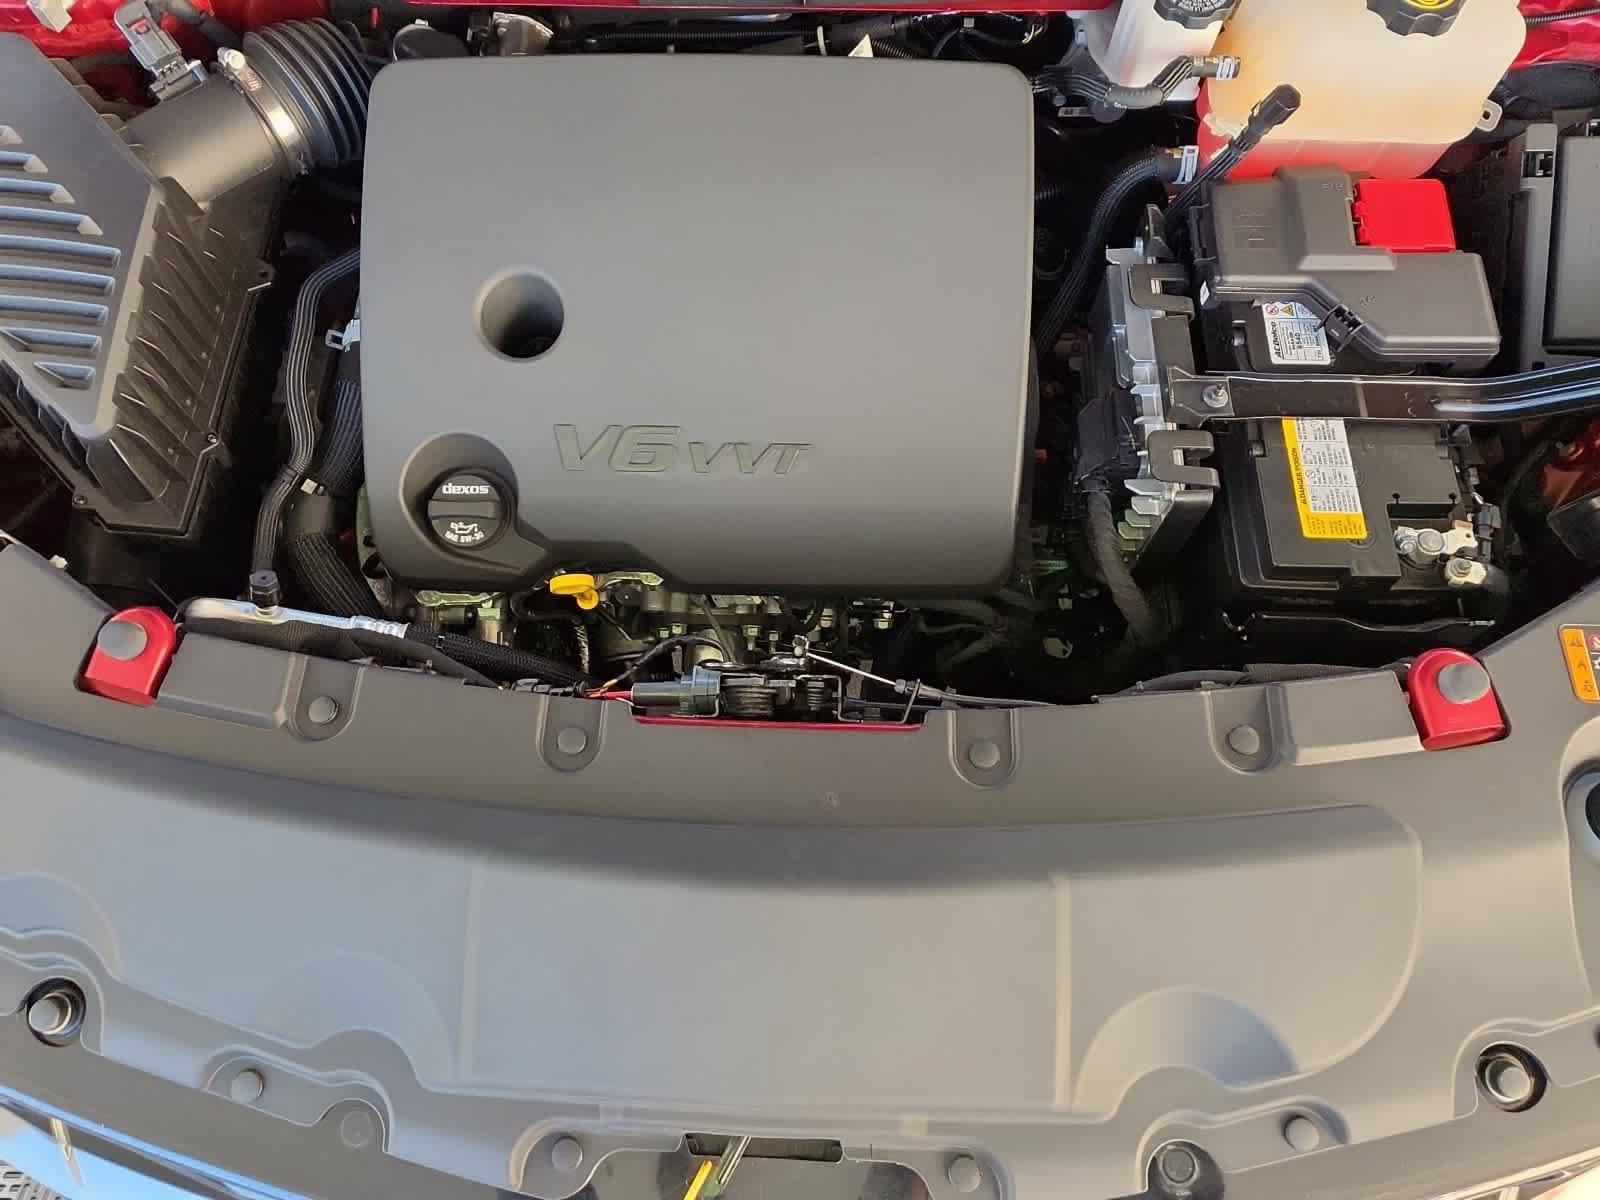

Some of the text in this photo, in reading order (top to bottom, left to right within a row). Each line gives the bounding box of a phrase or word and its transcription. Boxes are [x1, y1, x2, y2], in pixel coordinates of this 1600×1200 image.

[1271, 321, 1282, 358] ACDelco
[553, 424, 814, 475] V6 VVT
[442, 482, 490, 494] dexos
[1291, 447, 1306, 499] DANGER POISON
